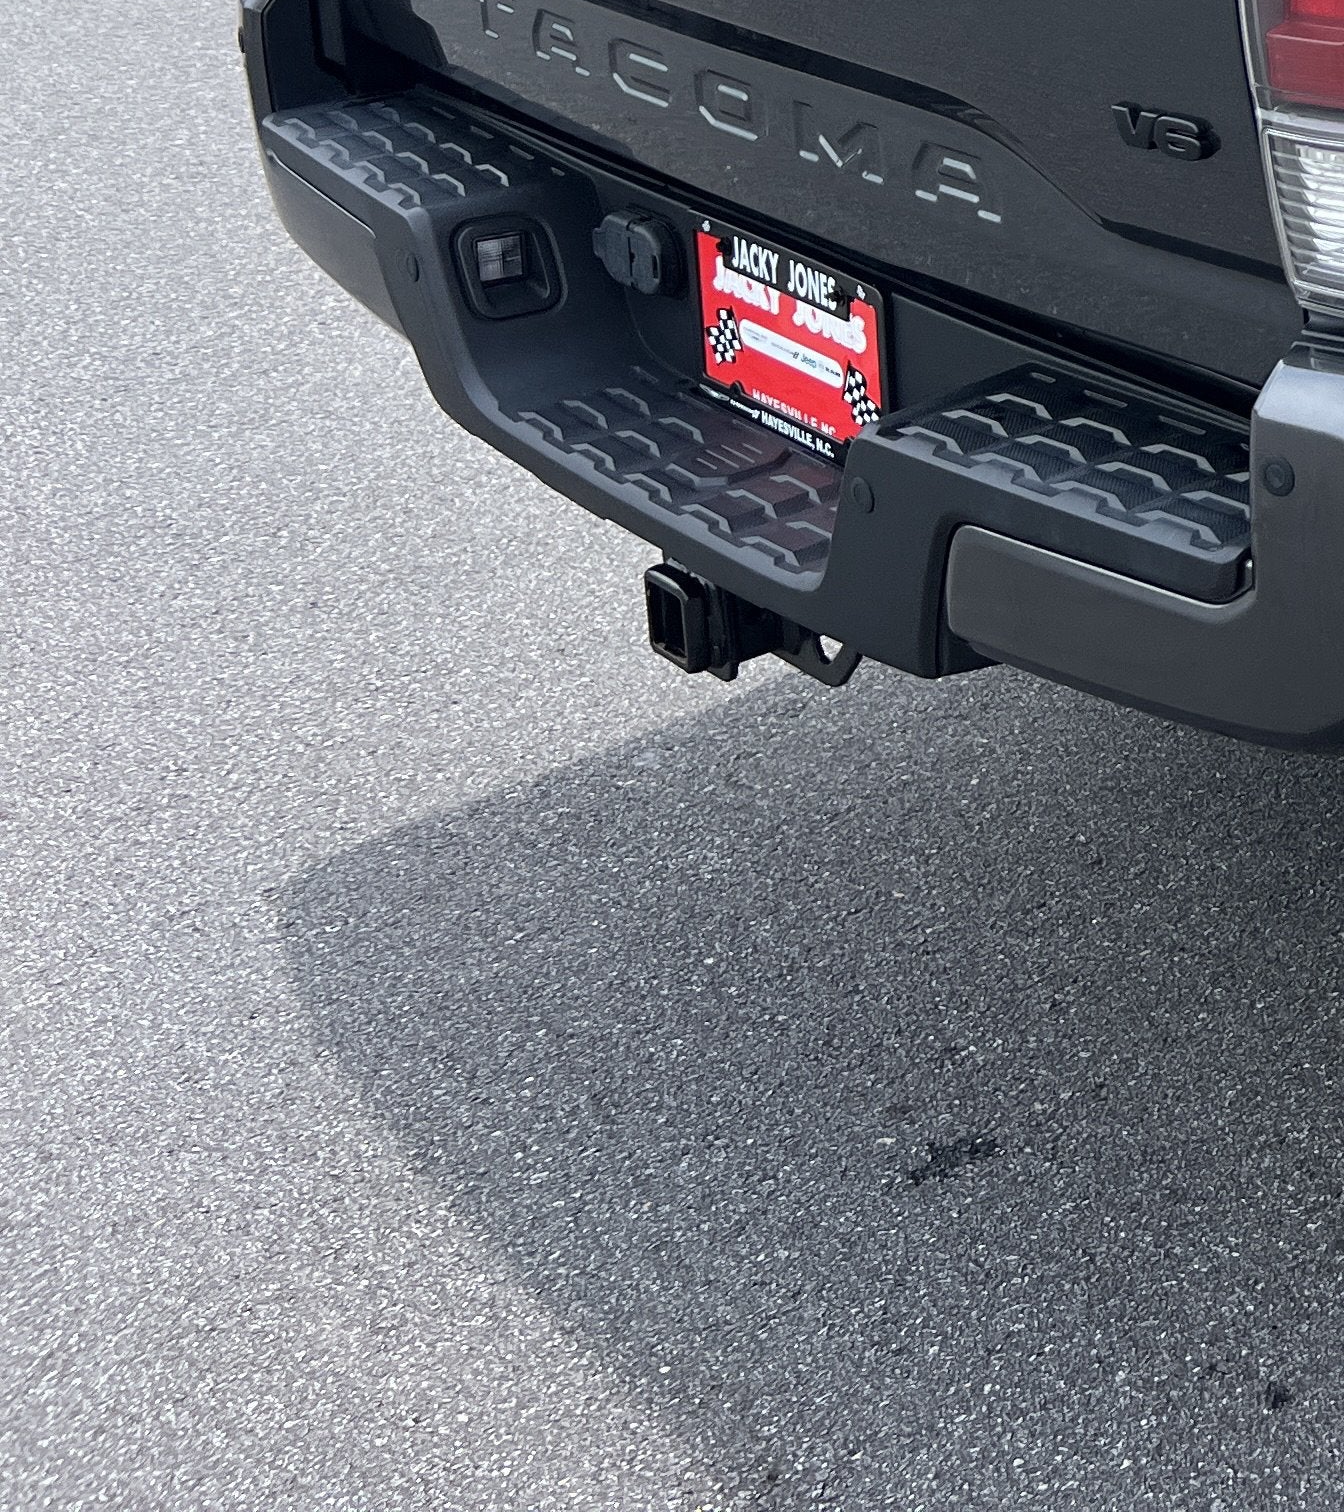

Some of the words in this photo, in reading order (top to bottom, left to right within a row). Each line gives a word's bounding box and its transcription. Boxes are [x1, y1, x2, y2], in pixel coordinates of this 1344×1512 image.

[1110, 101, 1219, 161] V6
[732, 236, 779, 284] JACKY
[787, 260, 837, 311] JONES
